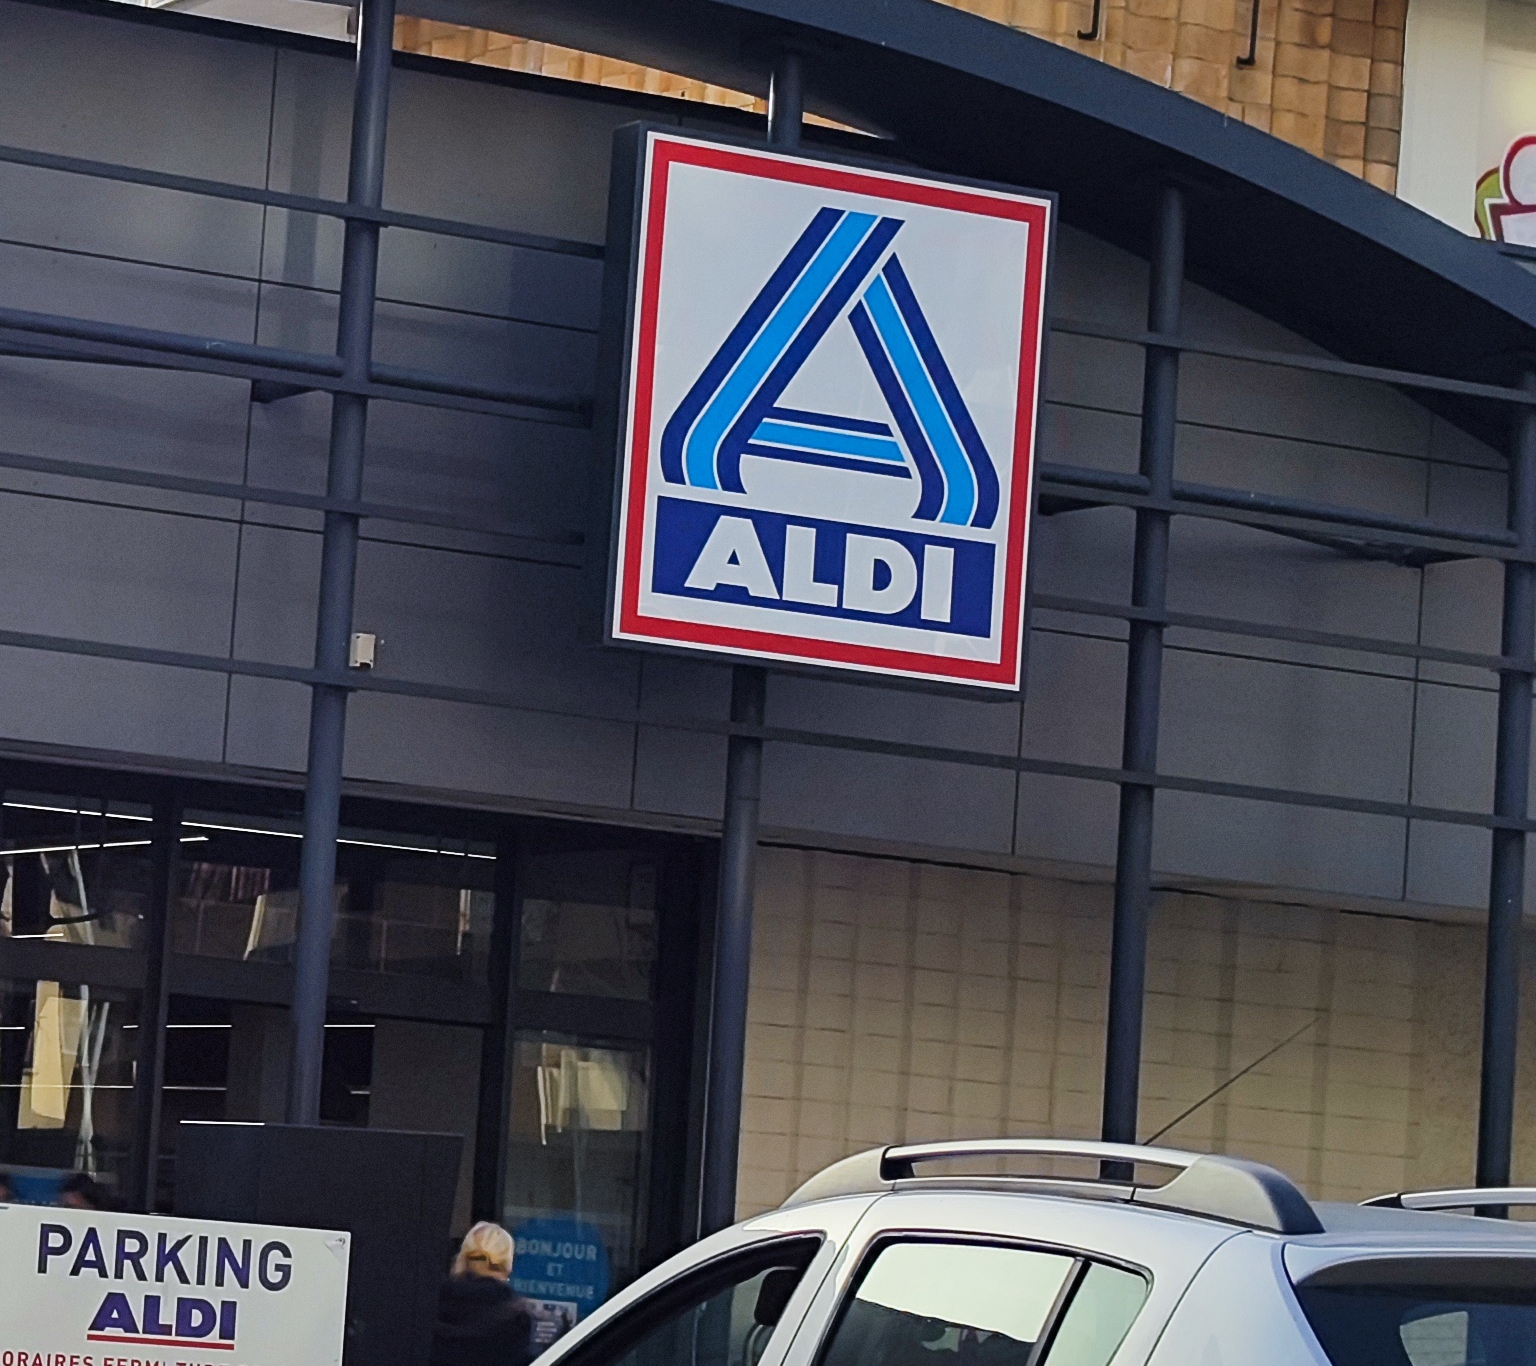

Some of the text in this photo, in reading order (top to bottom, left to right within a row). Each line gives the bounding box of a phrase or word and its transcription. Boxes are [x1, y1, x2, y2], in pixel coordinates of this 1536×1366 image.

[683, 514, 956, 624] ALDI
[37, 1222, 293, 1292] PARKING
[515, 1237, 597, 1261] BONJOUR
[87, 1291, 238, 1341] ALDI
